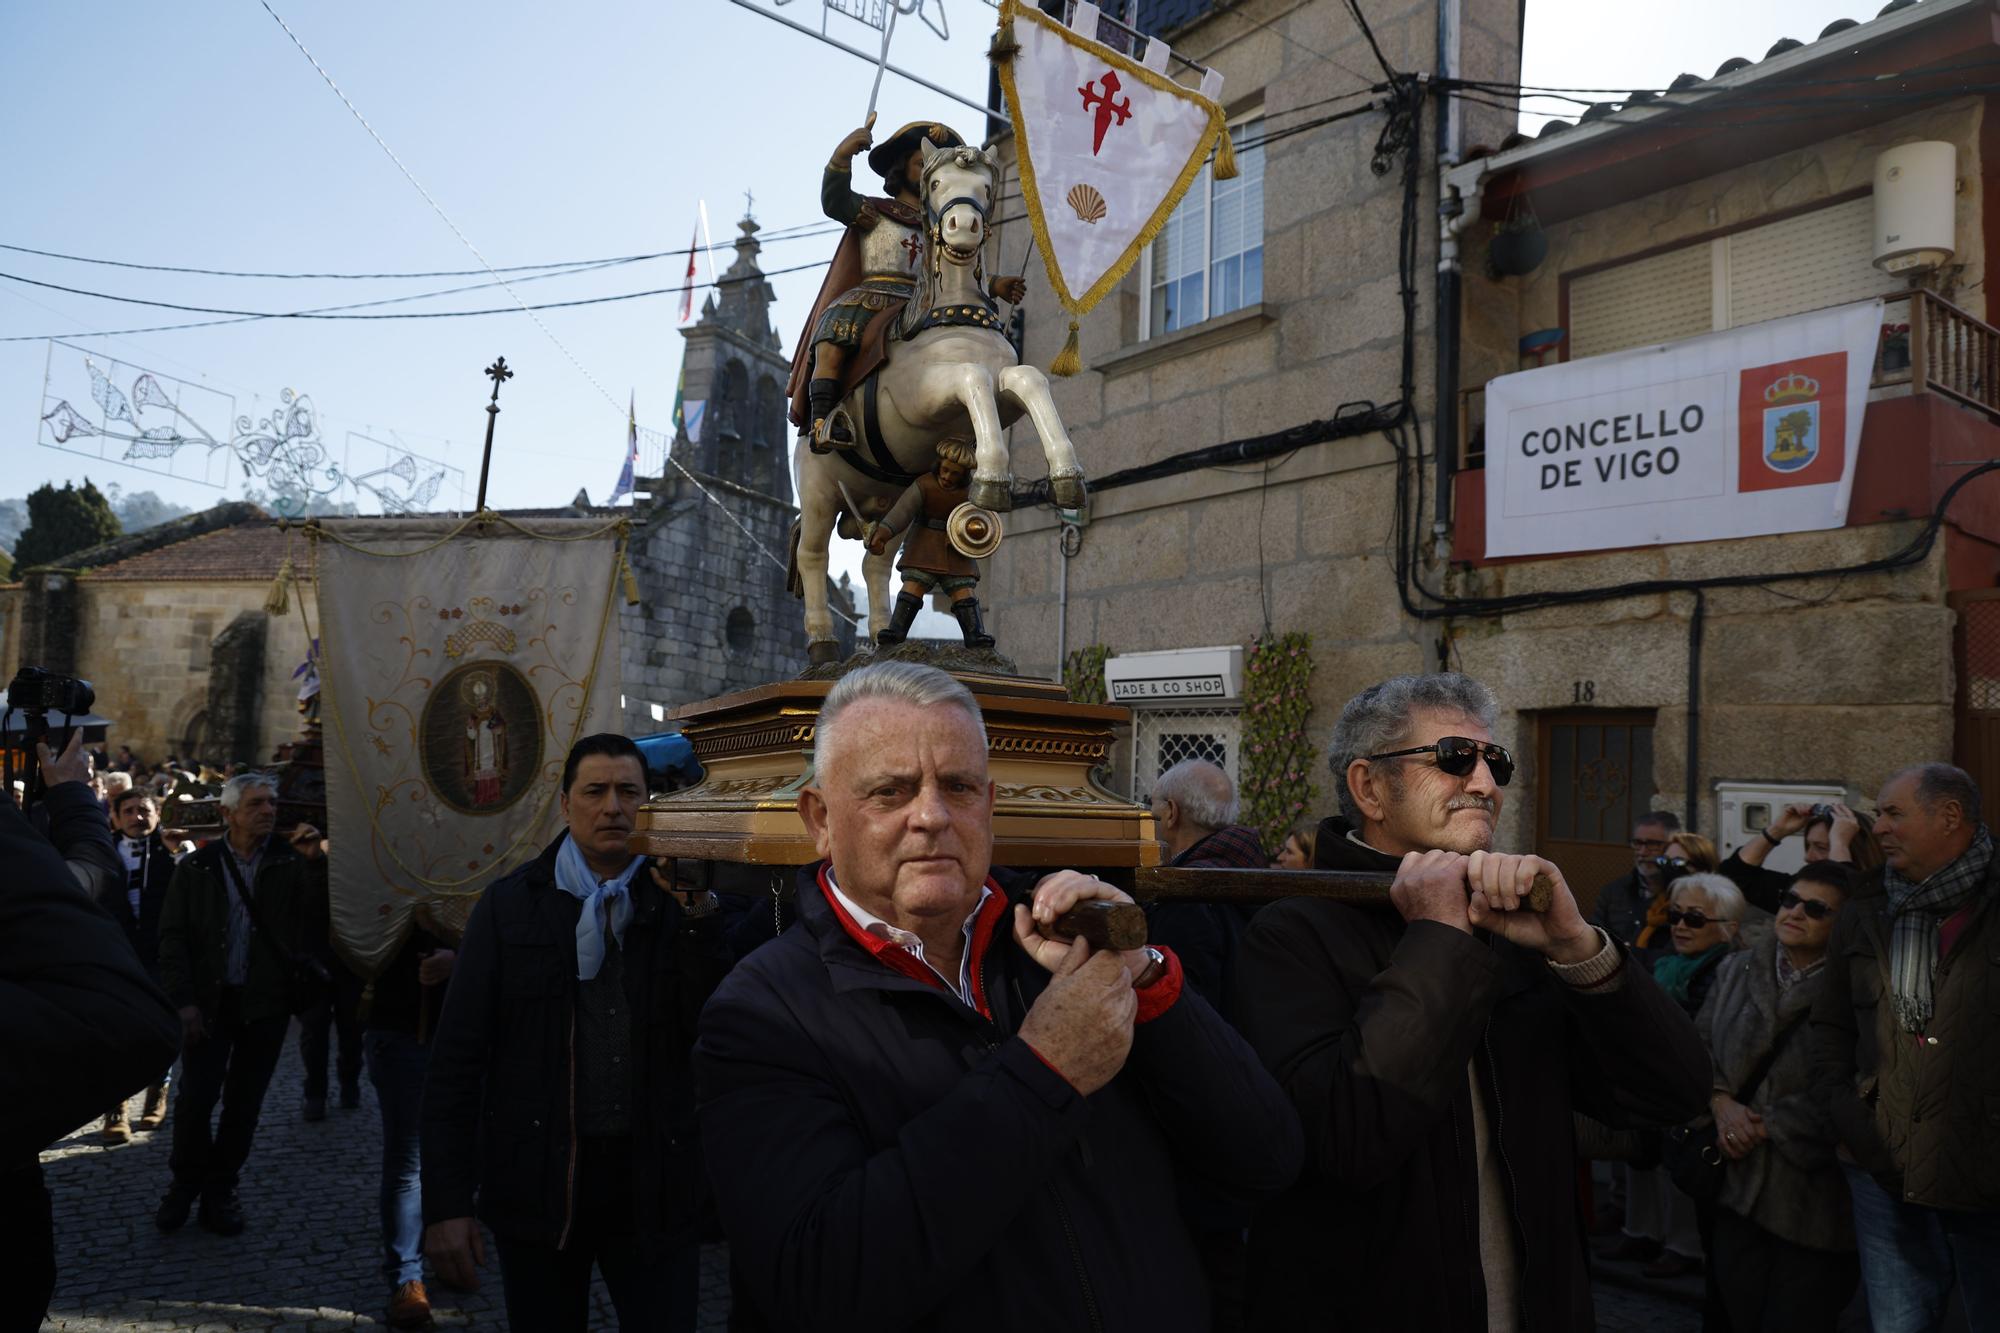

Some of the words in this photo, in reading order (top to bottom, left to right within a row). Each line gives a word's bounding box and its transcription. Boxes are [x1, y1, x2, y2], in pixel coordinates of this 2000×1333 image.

[1521, 404, 1704, 457] CONCELLO
[1540, 459, 1581, 490] DE
[1595, 446, 1680, 483] VIGO
[1115, 683, 1145, 695] JADE
[1151, 683, 1158, 693] &
[1163, 682, 1180, 693] CO
[1186, 680, 1221, 692] SHOP
[1573, 680, 1595, 702] 18
